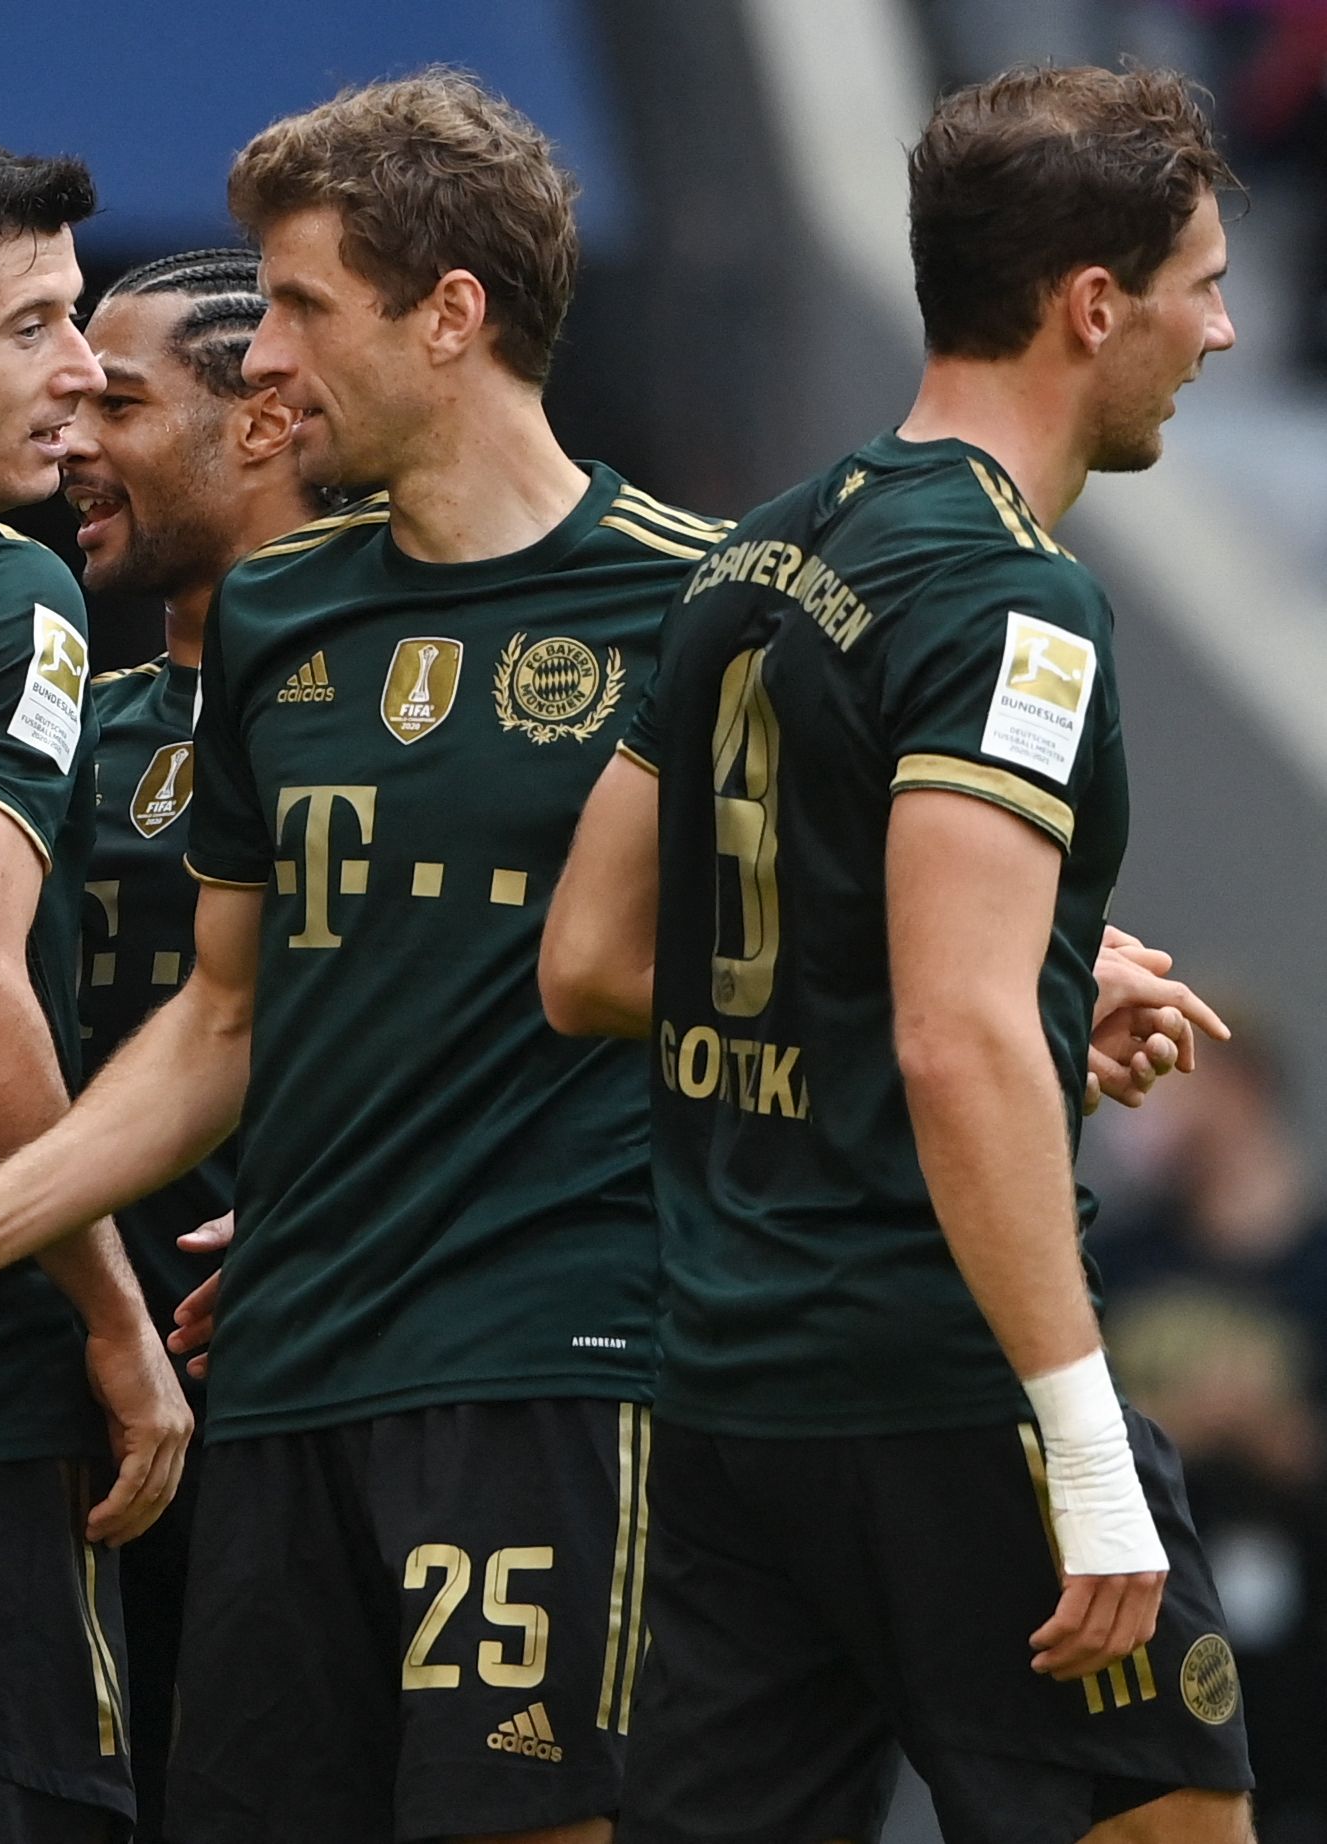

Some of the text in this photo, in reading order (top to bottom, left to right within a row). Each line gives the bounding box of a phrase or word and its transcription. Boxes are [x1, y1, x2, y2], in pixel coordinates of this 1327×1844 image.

[525, 644, 593, 678] FC BAYERN
[277, 686, 335, 703] adidas
[400, 704, 430, 717] FIFA
[1000, 695, 1074, 731] BUNDESLIGA
[145, 801, 174, 814] FIFA
[572, 1336, 627, 1350] AEROREADY
[402, 1543, 554, 1690] 25
[486, 1731, 563, 1763] adidas
